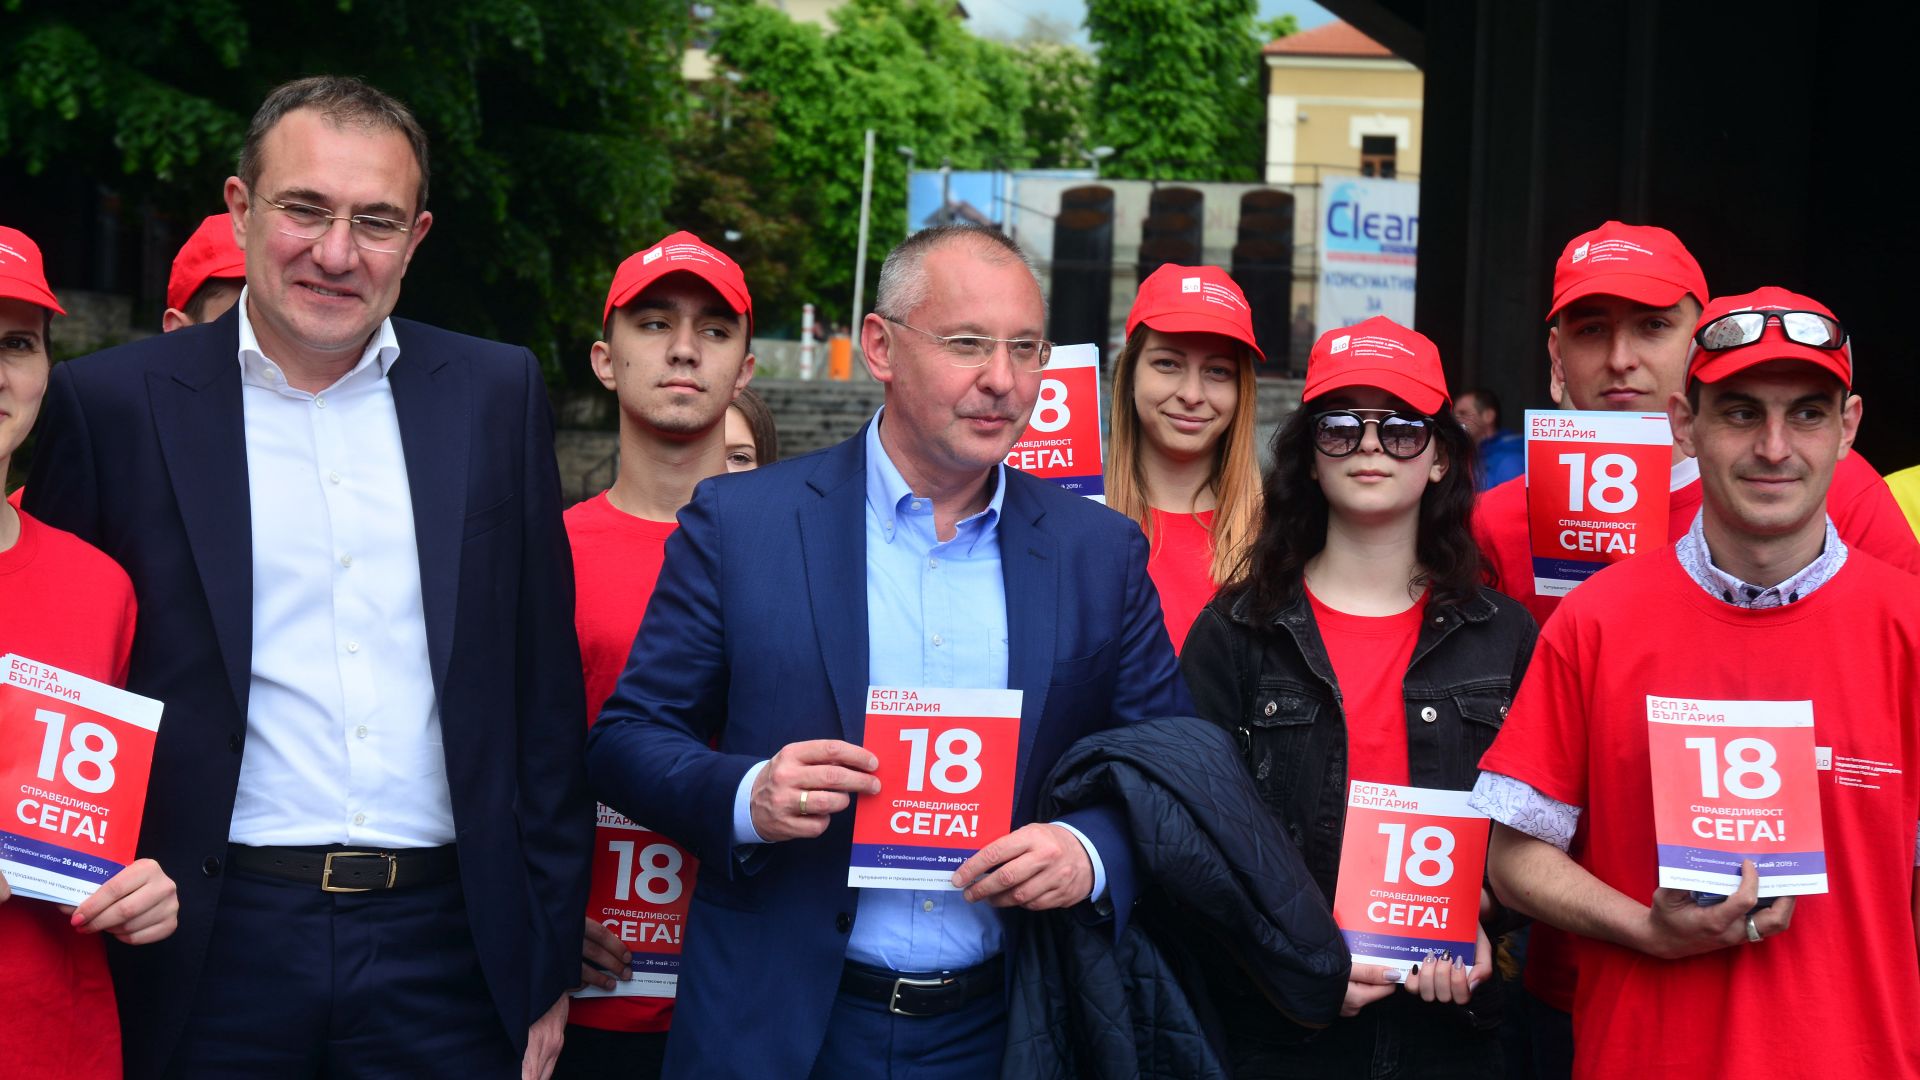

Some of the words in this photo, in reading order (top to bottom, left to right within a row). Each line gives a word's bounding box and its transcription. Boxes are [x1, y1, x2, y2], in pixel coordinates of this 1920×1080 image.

[1029, 378, 1071, 433] 8
[1532, 418, 1556, 427] БСП
[1559, 419, 1575, 428] ЗА
[1011, 438, 1072, 449] РАВЕДЛИВОСТ
[1532, 428, 1596, 439] БЪЛГАРИЯ
[1003, 448, 1074, 470] СЕГА!
[1558, 452, 1638, 514] 18
[1558, 519, 1637, 530] СПРАВЕДЛИВОСТ
[1559, 529, 1637, 555] СЕГА!
[11, 659, 39, 676] БСП
[42, 668, 59, 682] ЗА
[8, 671, 81, 701] БЪЛГАРИЯ
[871, 689, 898, 700] БСП
[902, 691, 918, 701] ЗА
[871, 701, 941, 713] БЪЛГАРИЯ
[1651, 700, 1678, 710] БСП
[1682, 701, 1699, 711] ЗА
[1652, 710, 1725, 723] БЪЛГАРИЯ
[34, 708, 118, 794] 18
[899, 728, 982, 794] 18
[1685, 737, 1782, 800] 18
[20, 784, 110, 817] СПРАВЕДЛИВОСТ
[1354, 784, 1379, 796] БСП
[1382, 787, 1397, 798] ЗА
[892, 799, 980, 812] СПРАВЕДЛИВОСТ
[1352, 795, 1418, 811] БЪЛГАРИЯ
[1690, 804, 1784, 816] СПРАВЕДЛИВОСТ
[16, 798, 108, 845] СЕГА!
[890, 810, 979, 838] СЕГА!
[1691, 816, 1786, 842] СЕГА!
[947, 856, 962, 864] май
[1378, 823, 1455, 887] 18
[61, 857, 72, 867] 26
[72, 860, 88, 871] май
[88, 864, 104, 875] 2019
[608, 840, 683, 905] 18
[1369, 889, 1450, 904] СПРАВЕДЛИВОСТ
[602, 907, 680, 921] СПРАВЕДЛИВОСТ
[1367, 901, 1449, 930] СЕГА!
